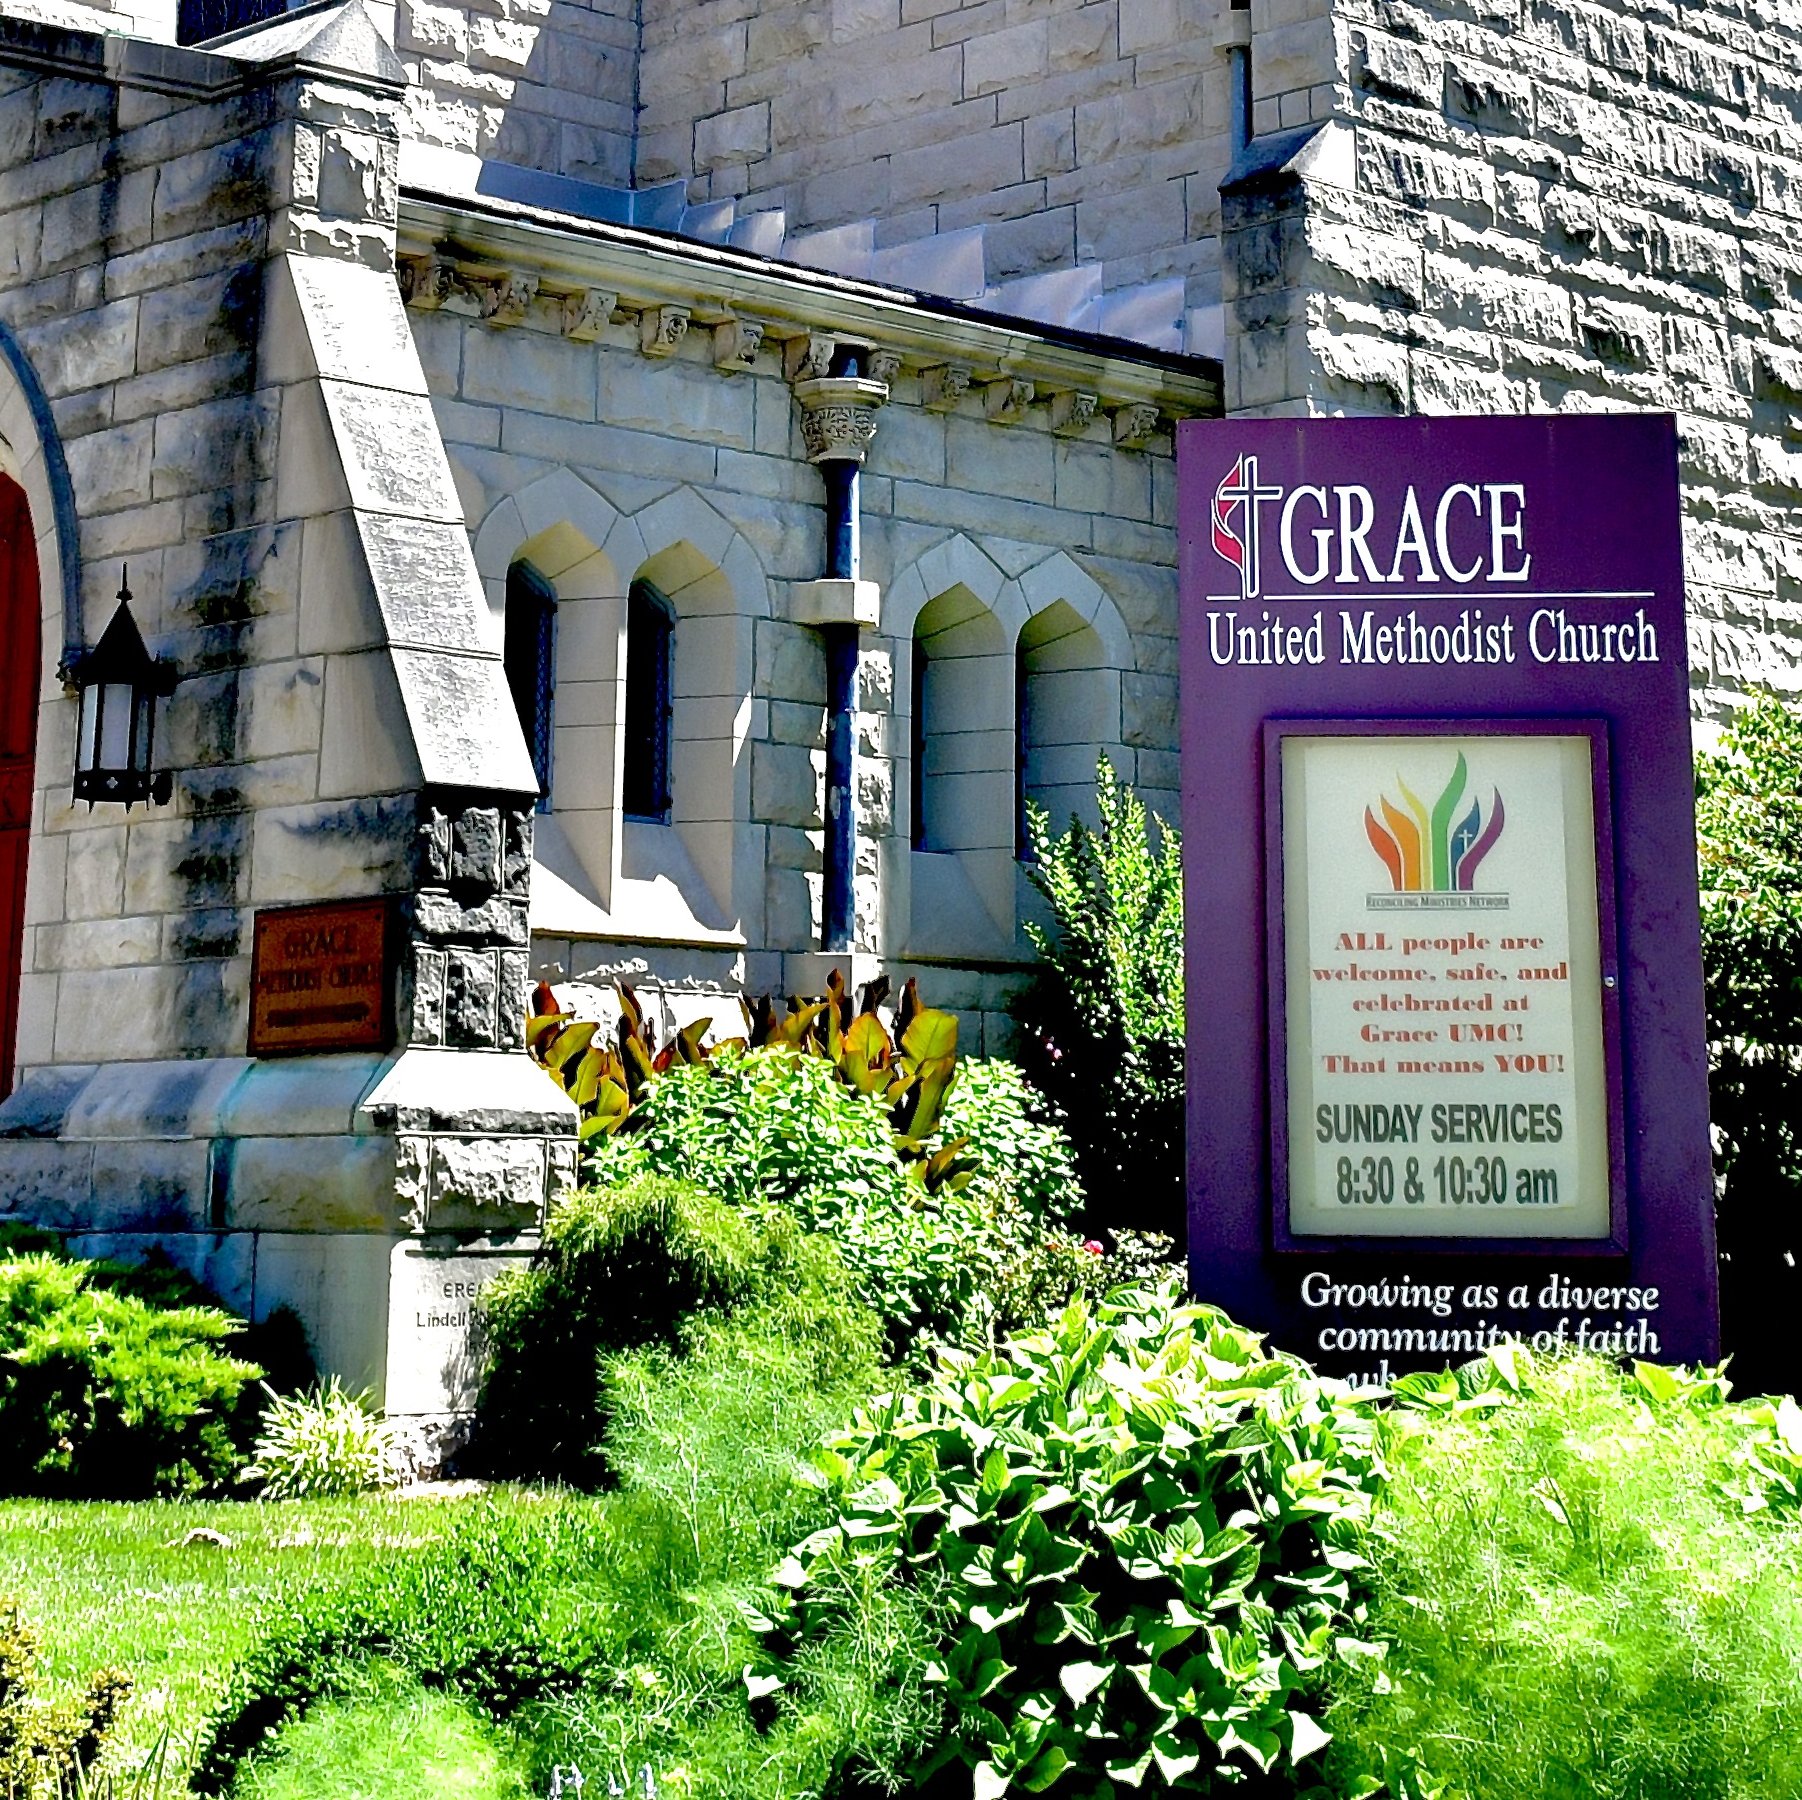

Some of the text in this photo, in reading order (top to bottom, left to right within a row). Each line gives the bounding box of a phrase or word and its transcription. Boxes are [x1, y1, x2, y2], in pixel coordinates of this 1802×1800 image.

[1279, 482, 1532, 585] GRACE
[1206, 608, 1660, 666] United Methodist Church
[1334, 932, 1545, 956] ALL people are
[1312, 962, 1568, 982] welcome, safe, and
[1352, 993, 1530, 1012] celebrated at
[1359, 1023, 1524, 1043] Grace UMC!
[1321, 1054, 1565, 1074] That means YOU!
[1315, 1103, 1563, 1144] SUNDAY SERVICES
[1336, 1155, 1559, 1205] 8:30 & 10:30 am
[1301, 1271, 1660, 1316] Growing as a diverse
[416, 1311, 466, 1328] Lindell
[1532, 1317, 1570, 1360] of
[1574, 1317, 1662, 1355] faith
